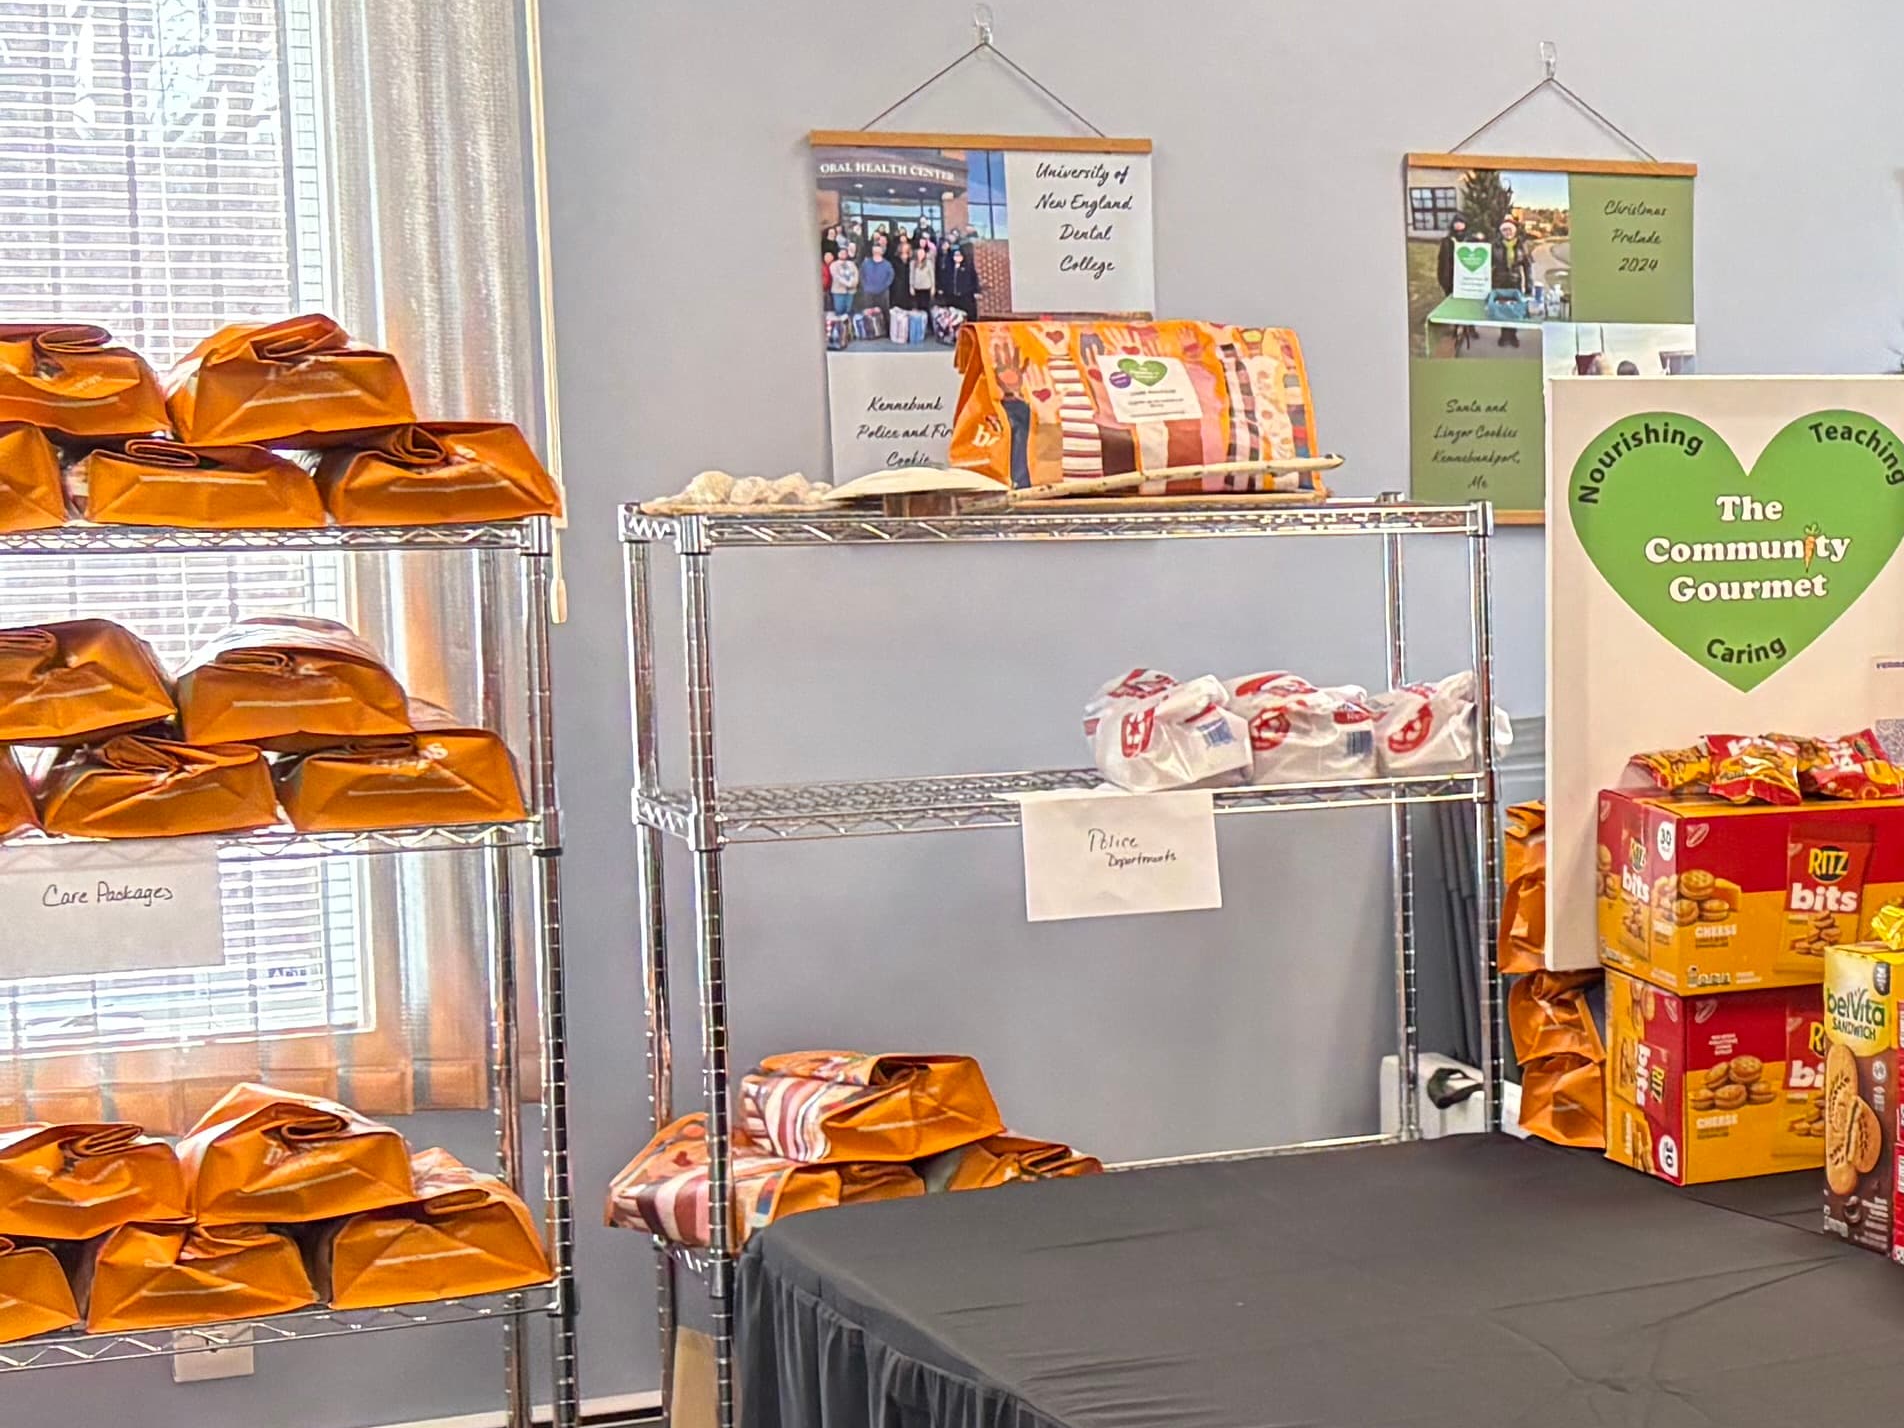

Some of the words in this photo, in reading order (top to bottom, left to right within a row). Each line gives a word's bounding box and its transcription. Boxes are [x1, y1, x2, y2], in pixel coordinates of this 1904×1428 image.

[820, 161, 851, 174] ORAL
[855, 162, 907, 176] HEALTH
[909, 165, 956, 182] CENTER
[1036, 163, 1108, 186] University
[1114, 165, 1131, 185] of
[1035, 194, 1066, 210] New
[1069, 193, 1132, 218] England
[1604, 200, 1667, 216] Christmas
[1060, 224, 1112, 241] Dental
[1611, 229, 1662, 245] Prelude
[1060, 255, 1115, 279] College
[1618, 257, 1658, 273] 2024
[867, 395, 944, 412] Kennebunk
[1446, 400, 1482, 414] Santa
[1484, 400, 1509, 413] and
[856, 423, 900, 440] Police
[902, 424, 929, 439] and
[931, 424, 952, 439] Fir
[1577, 422, 1703, 505] Nourishing
[1716, 495, 1784, 522] The
[1644, 529, 1851, 568] Community
[1668, 572, 1828, 604] Gourmet
[1706, 636, 1788, 665] Caring
[1088, 828, 1139, 853] Police
[1809, 847, 1849, 876] RITZ
[42, 884, 89, 907] Care
[96, 881, 174, 907] Packages
[1621, 867, 1650, 903] bits
[1790, 883, 1858, 913] bits
[1695, 924, 1737, 938] CHEESE
[1826, 986, 1885, 1027] belVita
[1832, 1020, 1876, 1041] SANDWICH
